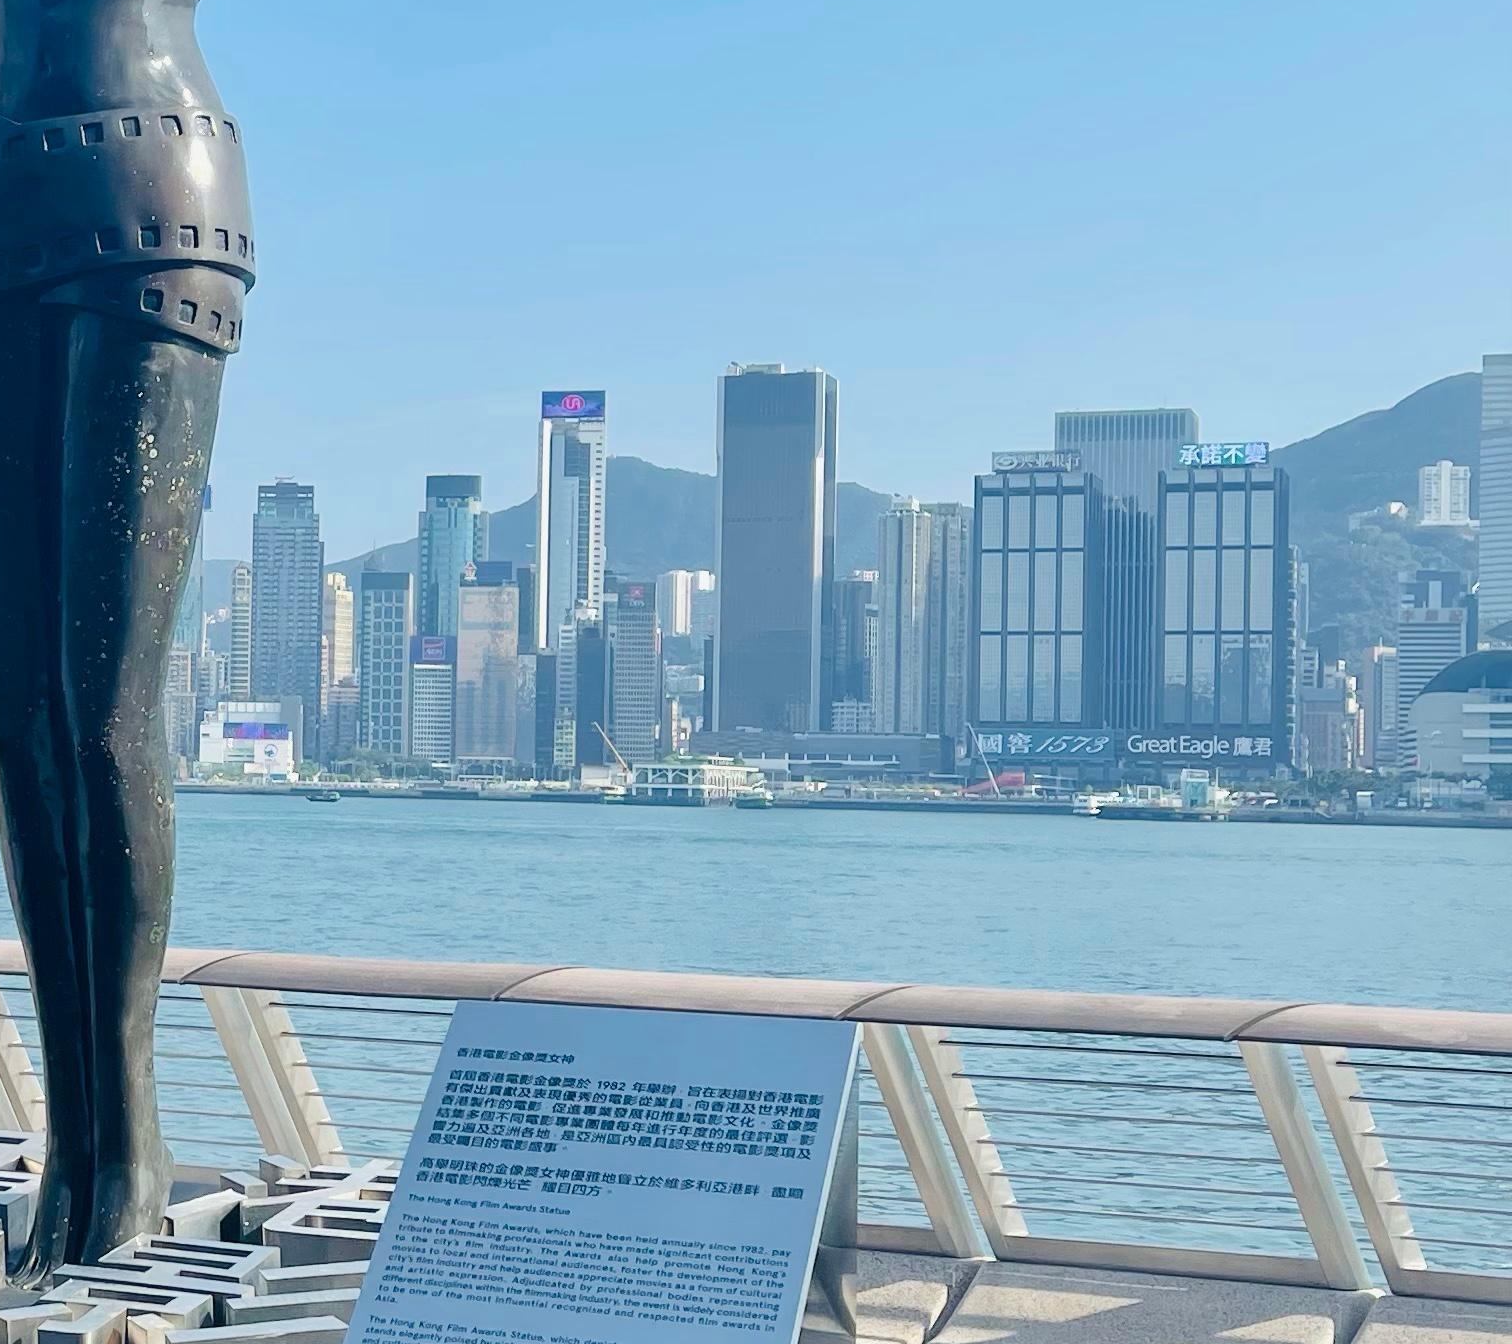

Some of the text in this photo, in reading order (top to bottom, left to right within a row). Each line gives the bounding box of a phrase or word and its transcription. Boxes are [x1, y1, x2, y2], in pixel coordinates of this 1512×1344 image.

[1179, 443, 1267, 465] 承諾不變
[1035, 735, 1110, 754] 1573
[1127, 734, 1273, 758] Great Eagle 鷹君
[597, 1080, 626, 1090] 1982
[426, 1196, 452, 1205] Hong
[453, 1198, 478, 1207] Kong
[502, 1203, 537, 1211] Awards
[538, 1206, 571, 1214] Statue
[398, 1224, 432, 1232] tribute
[447, 1229, 502, 1241] filmmaking
[504, 1234, 571, 1247] professionals
[626, 1246, 654, 1254] made
[657, 1249, 711, 1261] significant
[715, 1254, 788, 1266] contributions
[422, 1216, 447, 1225] Hong
[450, 1219, 475, 1228] Kong
[545, 1228, 575, 1236] which
[606, 1233, 631, 1241] been
[661, 1238, 705, 1250] annually
[709, 1243, 736, 1251] since
[771, 1250, 790, 1258] pay
[391, 1244, 426, 1252] movies
[470, 1251, 488, 1259] and
[492, 1254, 557, 1265] international
[621, 1266, 652, 1275] foster
[676, 1272, 747, 1286] development
[766, 1280, 783, 1288] the
[564, 1250, 601, 1259] Awards
[608, 1254, 628, 1262] also
[635, 1257, 658, 1266] help
[664, 1260, 711, 1272] promote
[717, 1265, 745, 1275] Hong
[408, 1266, 444, 1275] artistic
[511, 1277, 574, 1290] Adjudicated
[579, 1284, 592, 1292] by
[596, 1285, 662, 1299] professional
[667, 1292, 703, 1302] bodies
[708, 1297, 779, 1311] representing
[435, 1259, 476, 1270] industry
[499, 1265, 521, 1274] help
[524, 1267, 575, 1278] audiences
[577, 1273, 633, 1285] appreciate
[636, 1279, 672, 1287] movies
[697, 1285, 723, 1293] form
[739, 1289, 781, 1298] cultural
[382, 1274, 422, 1284] different
[424, 1278, 473, 1291] disciplines
[475, 1284, 504, 1292] within
[523, 1289, 577, 1301] filmmaking
[642, 1301, 669, 1309] event
[682, 1305, 714, 1316] widely
[716, 1308, 777, 1320] considered
[466, 1293, 491, 1301] most
[495, 1296, 547, 1307] influential
[551, 1302, 610, 1316] recognised
[637, 1311, 693, 1325] respected
[698, 1317, 718, 1325] film
[722, 1320, 760, 1330] awards
[365, 1326, 396, 1335] stands
[398, 1330, 442, 1342] elegantly
[389, 1318, 415, 1328] Hong
[418, 1321, 443, 1331] Kong
[447, 1324, 467, 1332] Film
[471, 1327, 507, 1336] Awards
[550, 1335, 580, 1344] which
